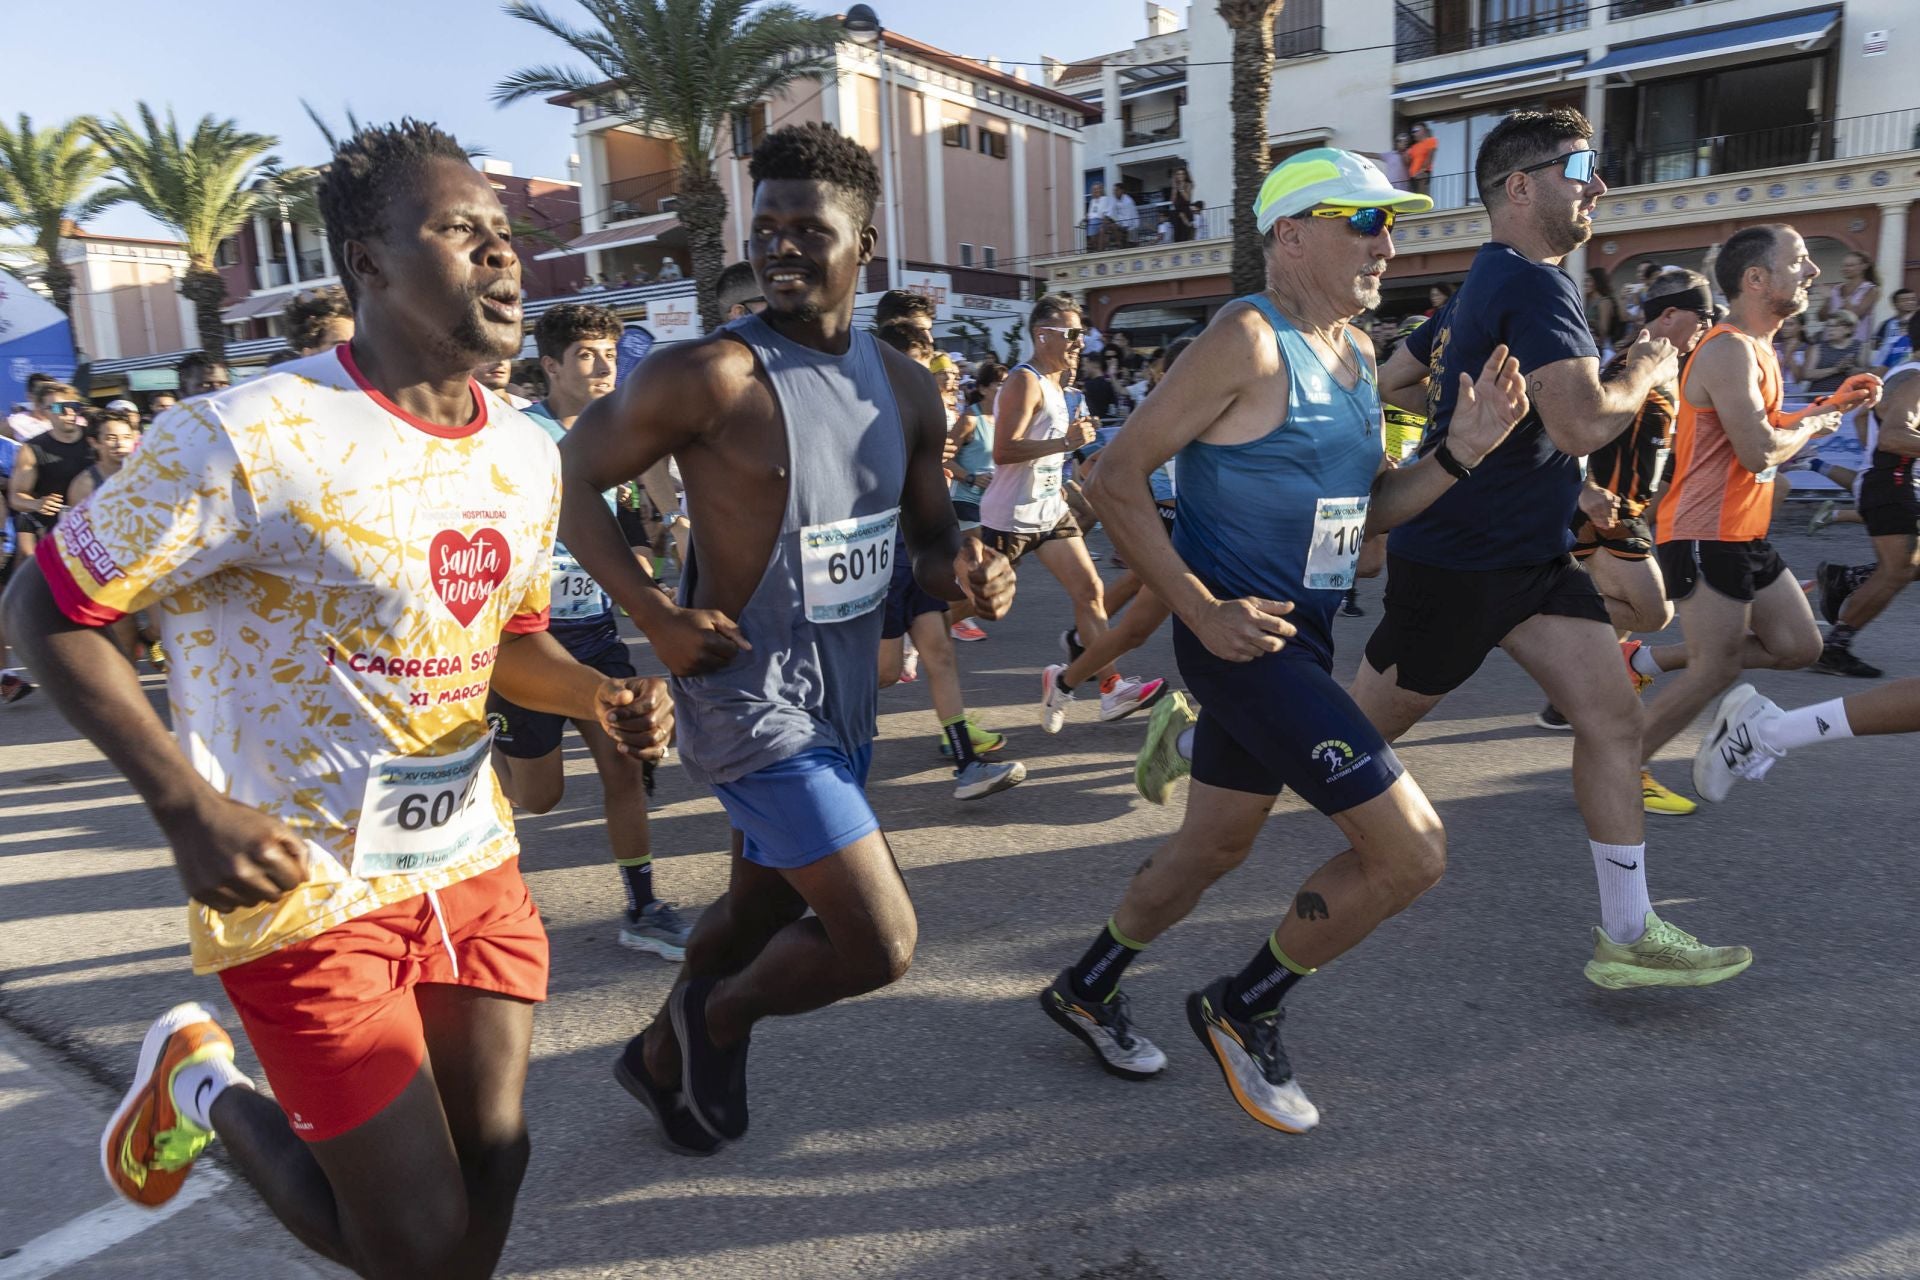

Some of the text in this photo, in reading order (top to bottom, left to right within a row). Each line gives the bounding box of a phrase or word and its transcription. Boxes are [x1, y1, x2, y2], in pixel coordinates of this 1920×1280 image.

[462, 509, 507, 519] HOSPITALIDAD
[439, 537, 501, 579] Santa
[828, 539, 889, 585] 6016
[438, 578, 495, 605] Teresa
[349, 652, 462, 678] CARRERA
[409, 692, 429, 706] XI
[404, 771, 420, 781] XV
[420, 767, 452, 781] CROSS
